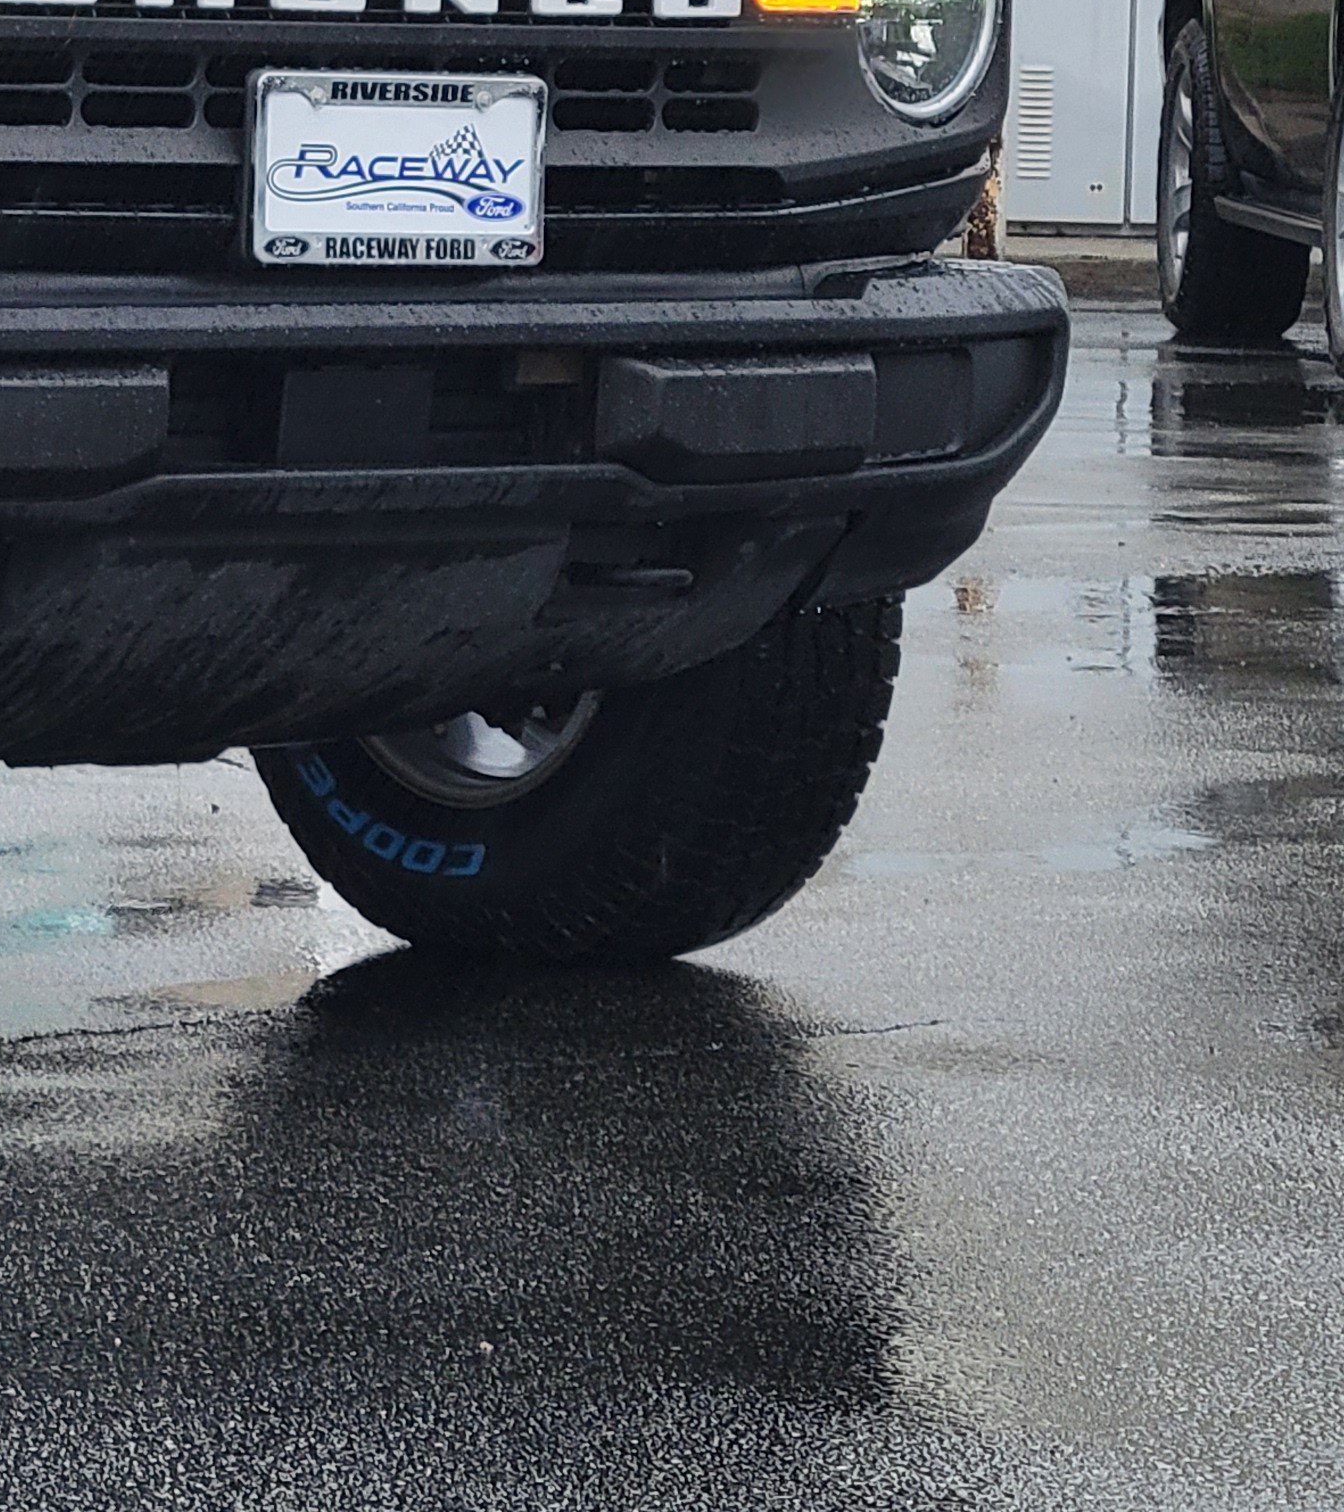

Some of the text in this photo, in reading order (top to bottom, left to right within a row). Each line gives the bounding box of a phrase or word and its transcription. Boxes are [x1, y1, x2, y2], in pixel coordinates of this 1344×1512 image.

[330, 80, 475, 103] RIVERSIDE
[293, 143, 525, 184] RACEWAY
[345, 200, 455, 213] Southern California Proud
[475, 195, 514, 218] Ford
[272, 237, 302, 257] Ford
[325, 236, 476, 261] RACEWAY FORD
[497, 239, 527, 259] Ford
[296, 752, 486, 876] COOPE
